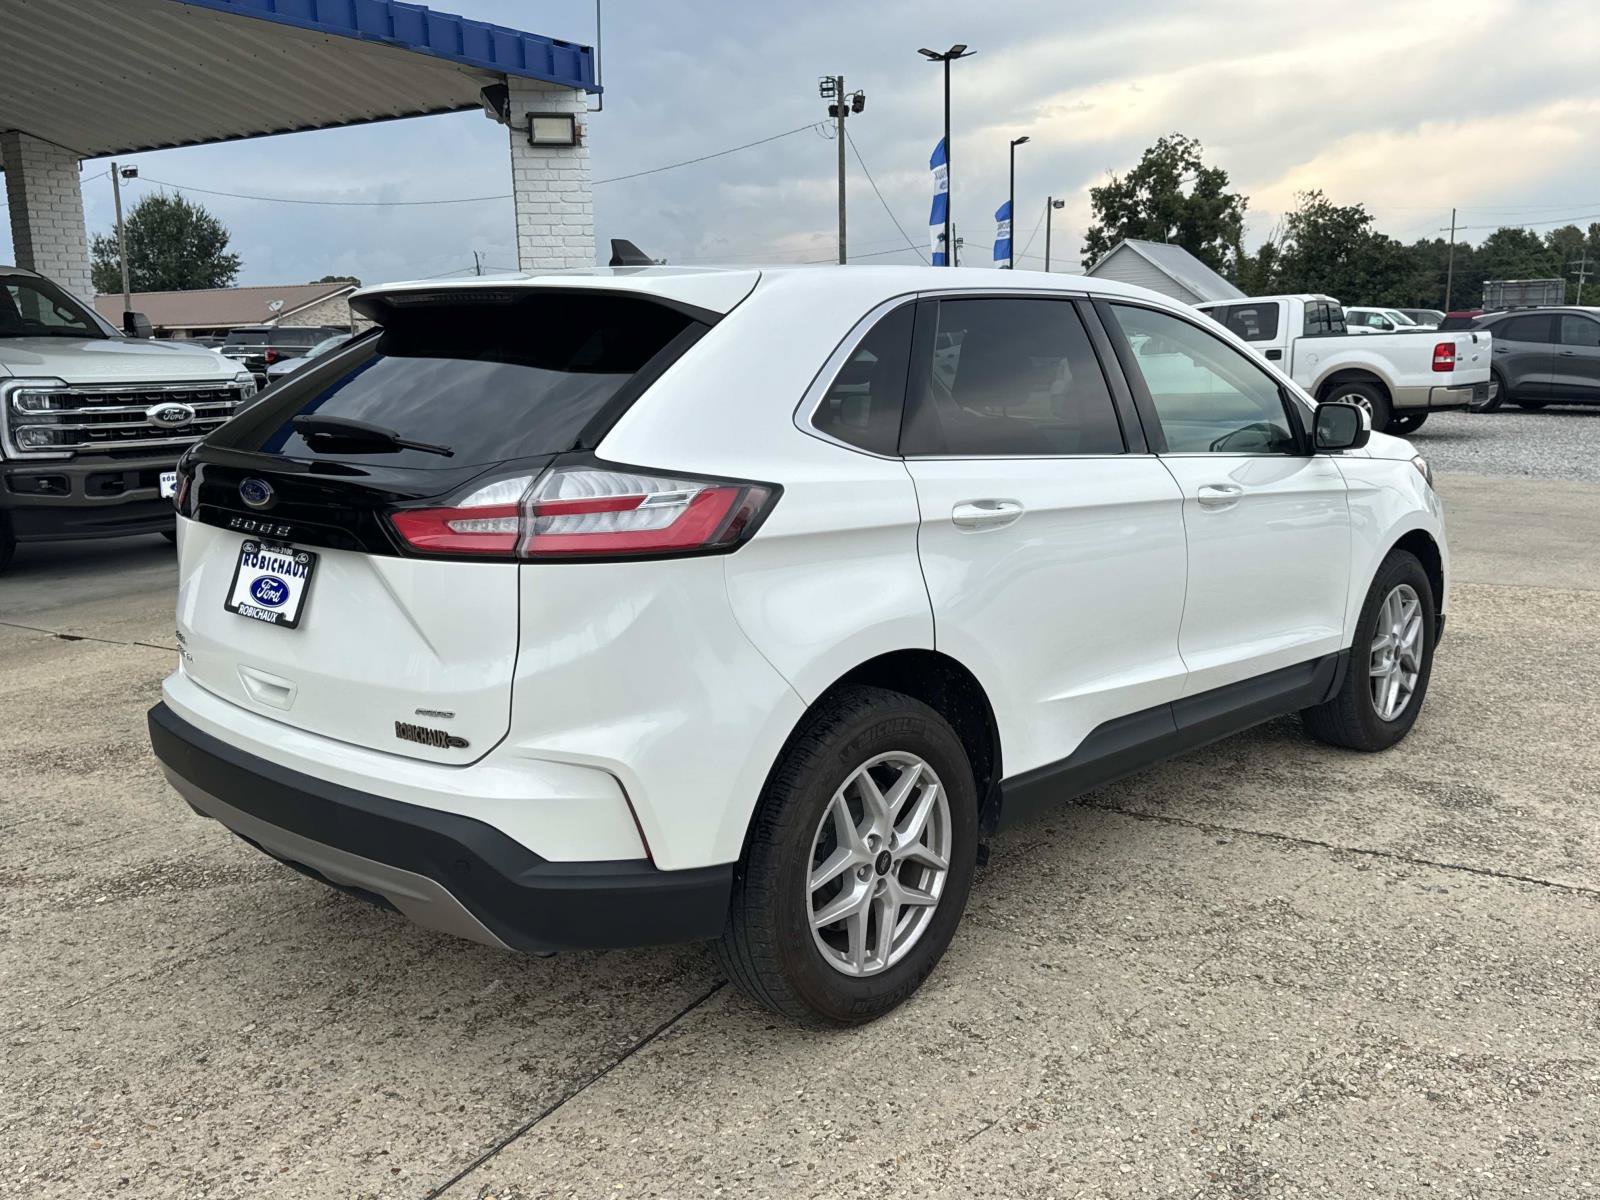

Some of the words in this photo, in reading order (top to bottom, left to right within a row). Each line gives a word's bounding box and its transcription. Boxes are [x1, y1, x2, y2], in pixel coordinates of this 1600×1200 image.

[162, 408, 186, 421] Ford
[242, 552, 309, 579] ROBICHAUX
[256, 578, 283, 603] Ford
[238, 603, 279, 623] ROBICHAUX
[394, 720, 450, 749] ROBICHAUX
